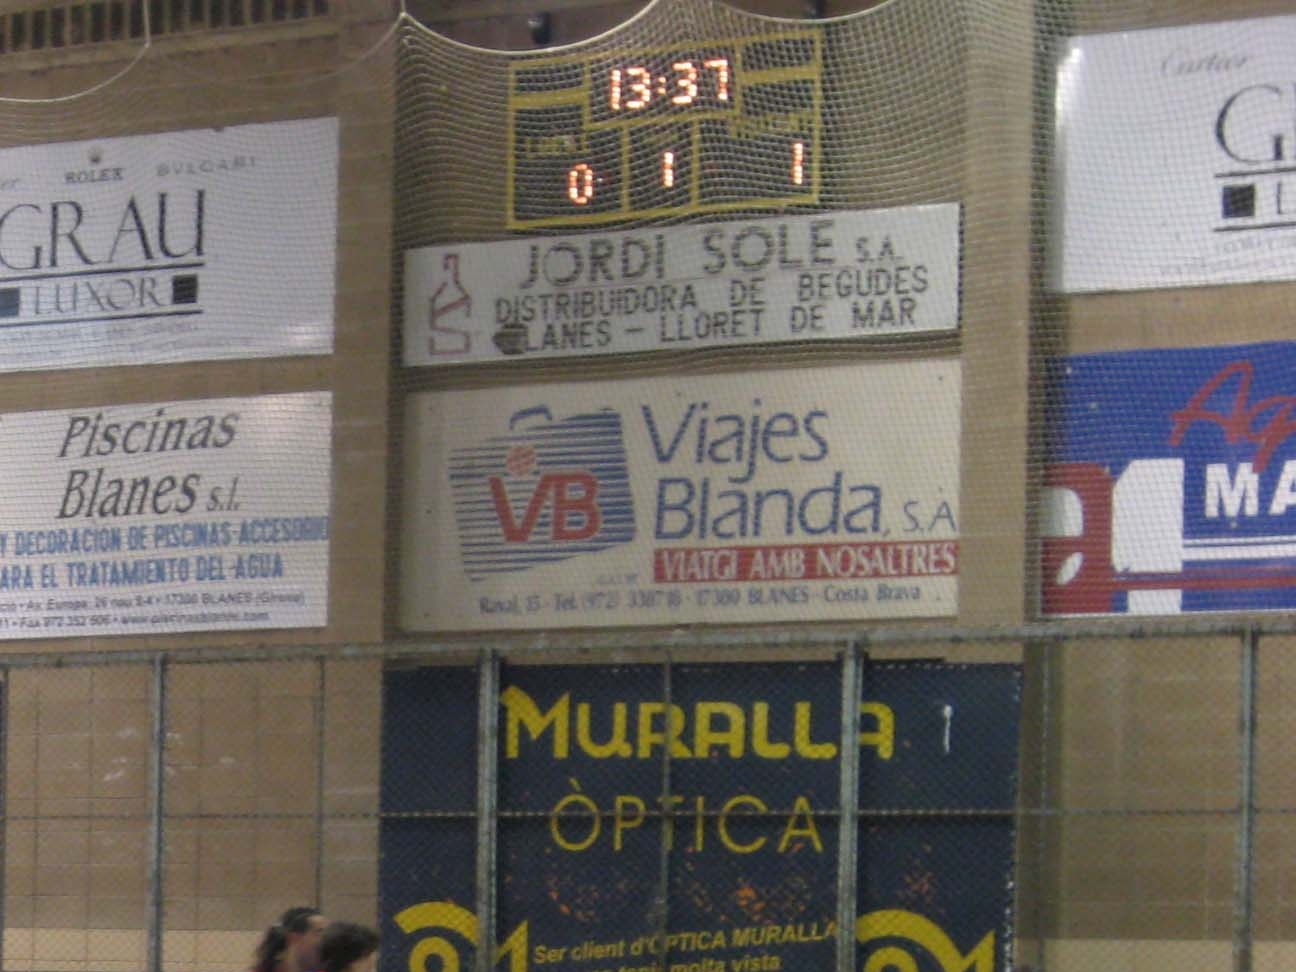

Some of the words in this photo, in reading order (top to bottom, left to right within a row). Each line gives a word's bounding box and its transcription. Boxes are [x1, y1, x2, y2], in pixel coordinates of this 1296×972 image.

[610, 58, 729, 110] 13:37
[65, 167, 124, 184] ROLEX
[568, 163, 594, 204] 0
[661, 152, 675, 188] 1
[790, 142, 805, 185] 1
[520, 233, 664, 288] JORDI
[703, 219, 835, 273] SOLE
[33, 277, 161, 316] LUXOR
[495, 284, 697, 323] DISTRIBUIDORA
[729, 276, 766, 307] DE
[798, 265, 929, 302] BEGUDES
[660, 308, 765, 342] LLORET
[790, 304, 826, 333] DE
[851, 298, 918, 328] MAR
[57, 407, 241, 459] Piscinas
[642, 398, 830, 485] Viajes
[55, 467, 202, 520] Blanes
[488, 471, 604, 542] VB
[0, 531, 9, 556] Y
[127, 525, 147, 550] DE
[661, 548, 736, 581] VIATGI
[751, 546, 805, 580] AMB
[818, 542, 957, 578] NOSALTRES
[41, 564, 58, 589] EL
[67, 556, 189, 587] TRATAMIENTO
[196, 554, 225, 581] DEL
[235, 552, 284, 580] AGUA
[203, 591, 253, 604] BLANES
[748, 585, 809, 605] BLANES
[824, 583, 868, 602] Costa
[877, 582, 921, 601] Brava
[498, 684, 895, 762] MURALLA
[549, 777, 824, 854] ÒPTICA
[533, 944, 567, 965] Ser
[572, 939, 626, 962] client
[732, 920, 840, 947] MURALLA
